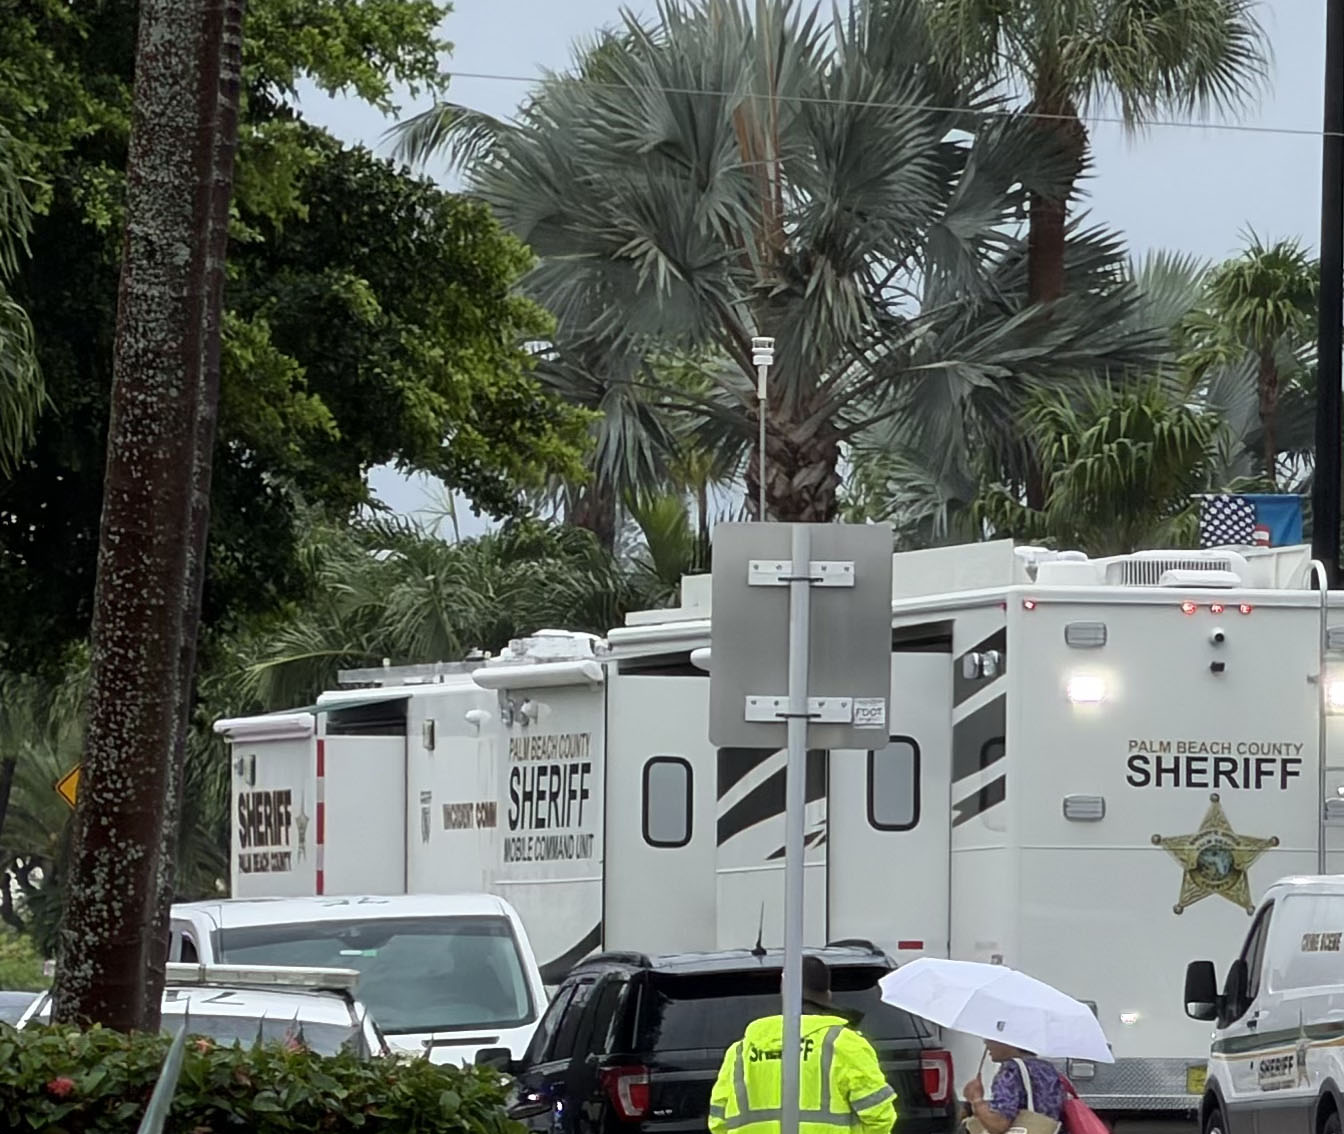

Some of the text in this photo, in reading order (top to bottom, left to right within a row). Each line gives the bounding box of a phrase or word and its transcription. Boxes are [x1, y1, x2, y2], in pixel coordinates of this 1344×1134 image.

[1128, 740, 1304, 755] PALM BEACH COUNTY
[1126, 755, 1302, 789] SHERIFF
[238, 789, 292, 848] SHERIFF
[508, 762, 591, 831] SHERIFF
